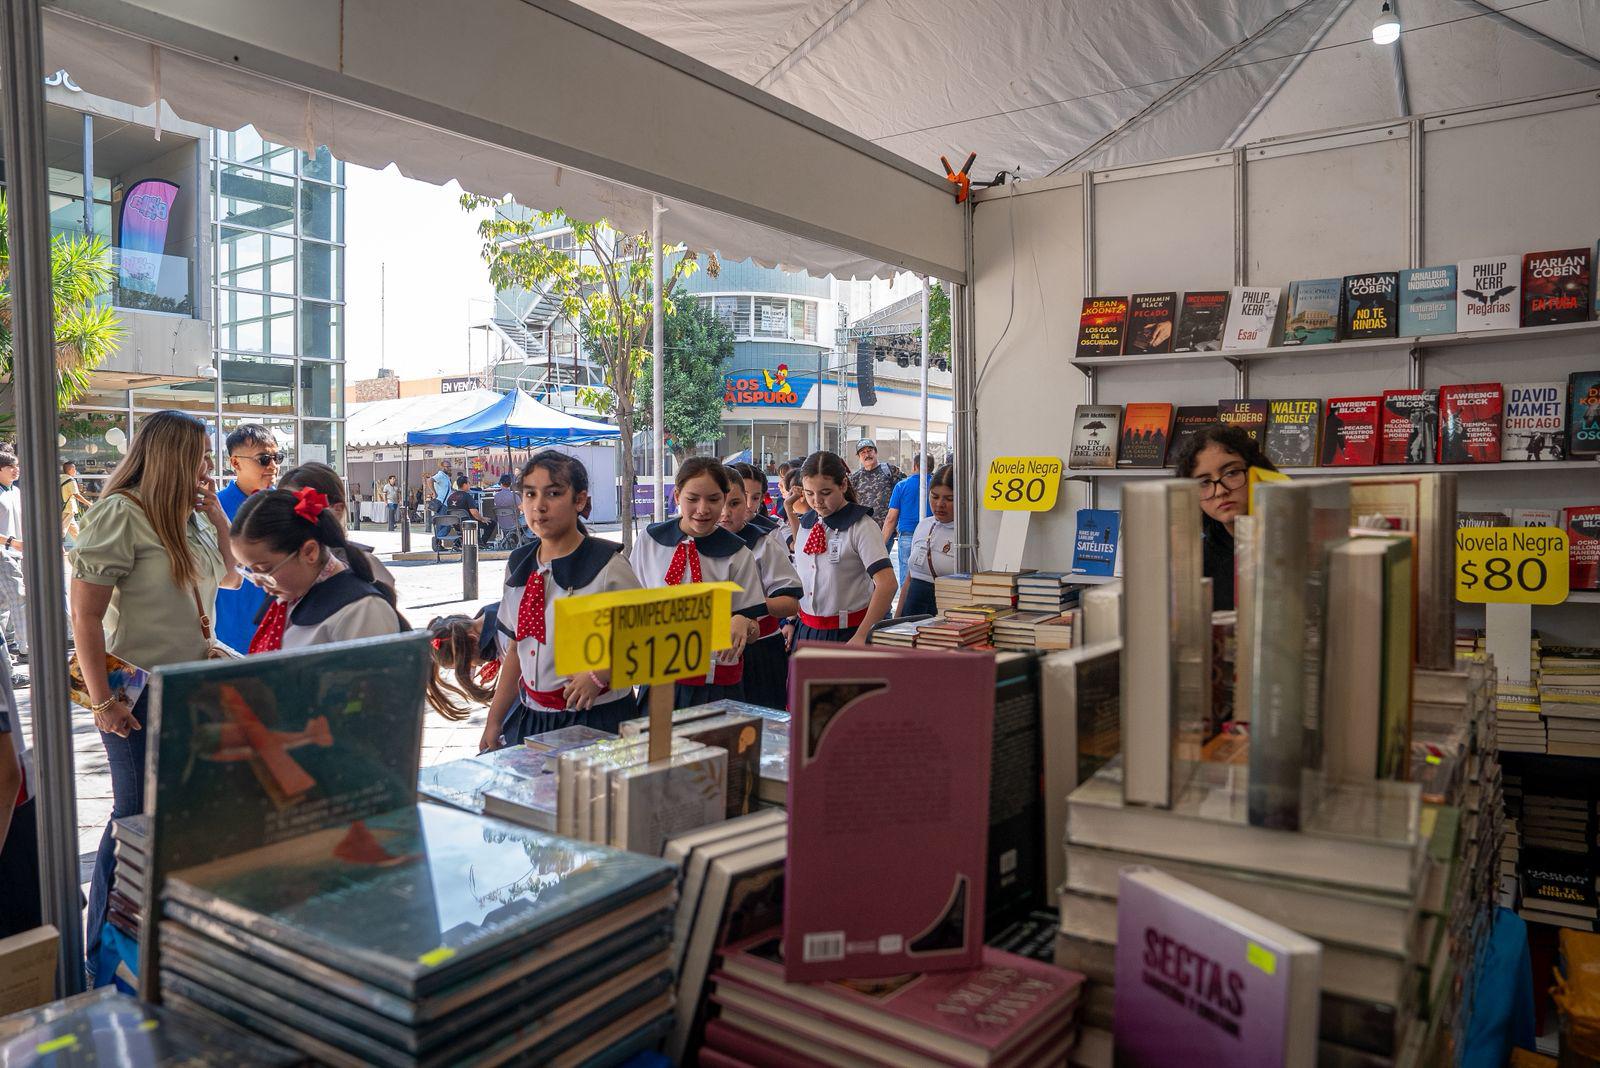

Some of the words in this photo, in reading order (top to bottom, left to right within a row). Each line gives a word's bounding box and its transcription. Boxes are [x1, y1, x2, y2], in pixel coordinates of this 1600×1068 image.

[1530, 256, 1585, 269] HARLAN
[1410, 270, 1447, 281] ARNALDUR
[1473, 262, 1506, 277] PHILIP
[1533, 266, 1580, 278] COBEN
[1349, 276, 1396, 288] HARLAN
[1476, 276, 1503, 290] KERR
[1352, 284, 1392, 295] COBEN
[1136, 296, 1170, 304] BENJAMIN
[1242, 292, 1270, 304] PHILIP
[1085, 305, 1124, 315] KOONTZ
[1241, 304, 1265, 316] KERR
[1410, 303, 1447, 313] Naturaleza
[1467, 302, 1510, 316] Plegarias
[1532, 298, 1546, 312] EN
[1357, 308, 1370, 320] NO
[1372, 307, 1384, 318] TE
[1352, 318, 1387, 330] RINDAS
[1237, 328, 1258, 341] Esaú
[442, 383, 452, 392] EN
[726, 378, 760, 391] LOS
[724, 391, 798, 404] AISPURO
[1447, 392, 1499, 400] LAWRENCE
[1512, 388, 1558, 402] DAVID
[1235, 403, 1250, 412] LEE
[1271, 402, 1317, 414] WALTER
[1456, 398, 1488, 406] BLOCK
[1506, 402, 1560, 416] MAMET
[1220, 413, 1263, 423] GOLDBERG
[1275, 414, 1310, 424] MOSLEY
[1506, 418, 1560, 428] CHICAGO
[1075, 444, 1111, 452] POLICÍA
[990, 460, 1025, 474] Novela
[1027, 460, 1058, 477] Negra
[990, 478, 1046, 502] $80
[1076, 541, 1114, 553] SATÉLITES
[1456, 532, 1508, 551] Novela
[1513, 532, 1563, 556] Negra
[1460, 558, 1548, 592] $80
[618, 596, 712, 630] ROMPECABEZAS
[626, 630, 703, 679] $120
[1144, 927, 1246, 1016] SECTAS
